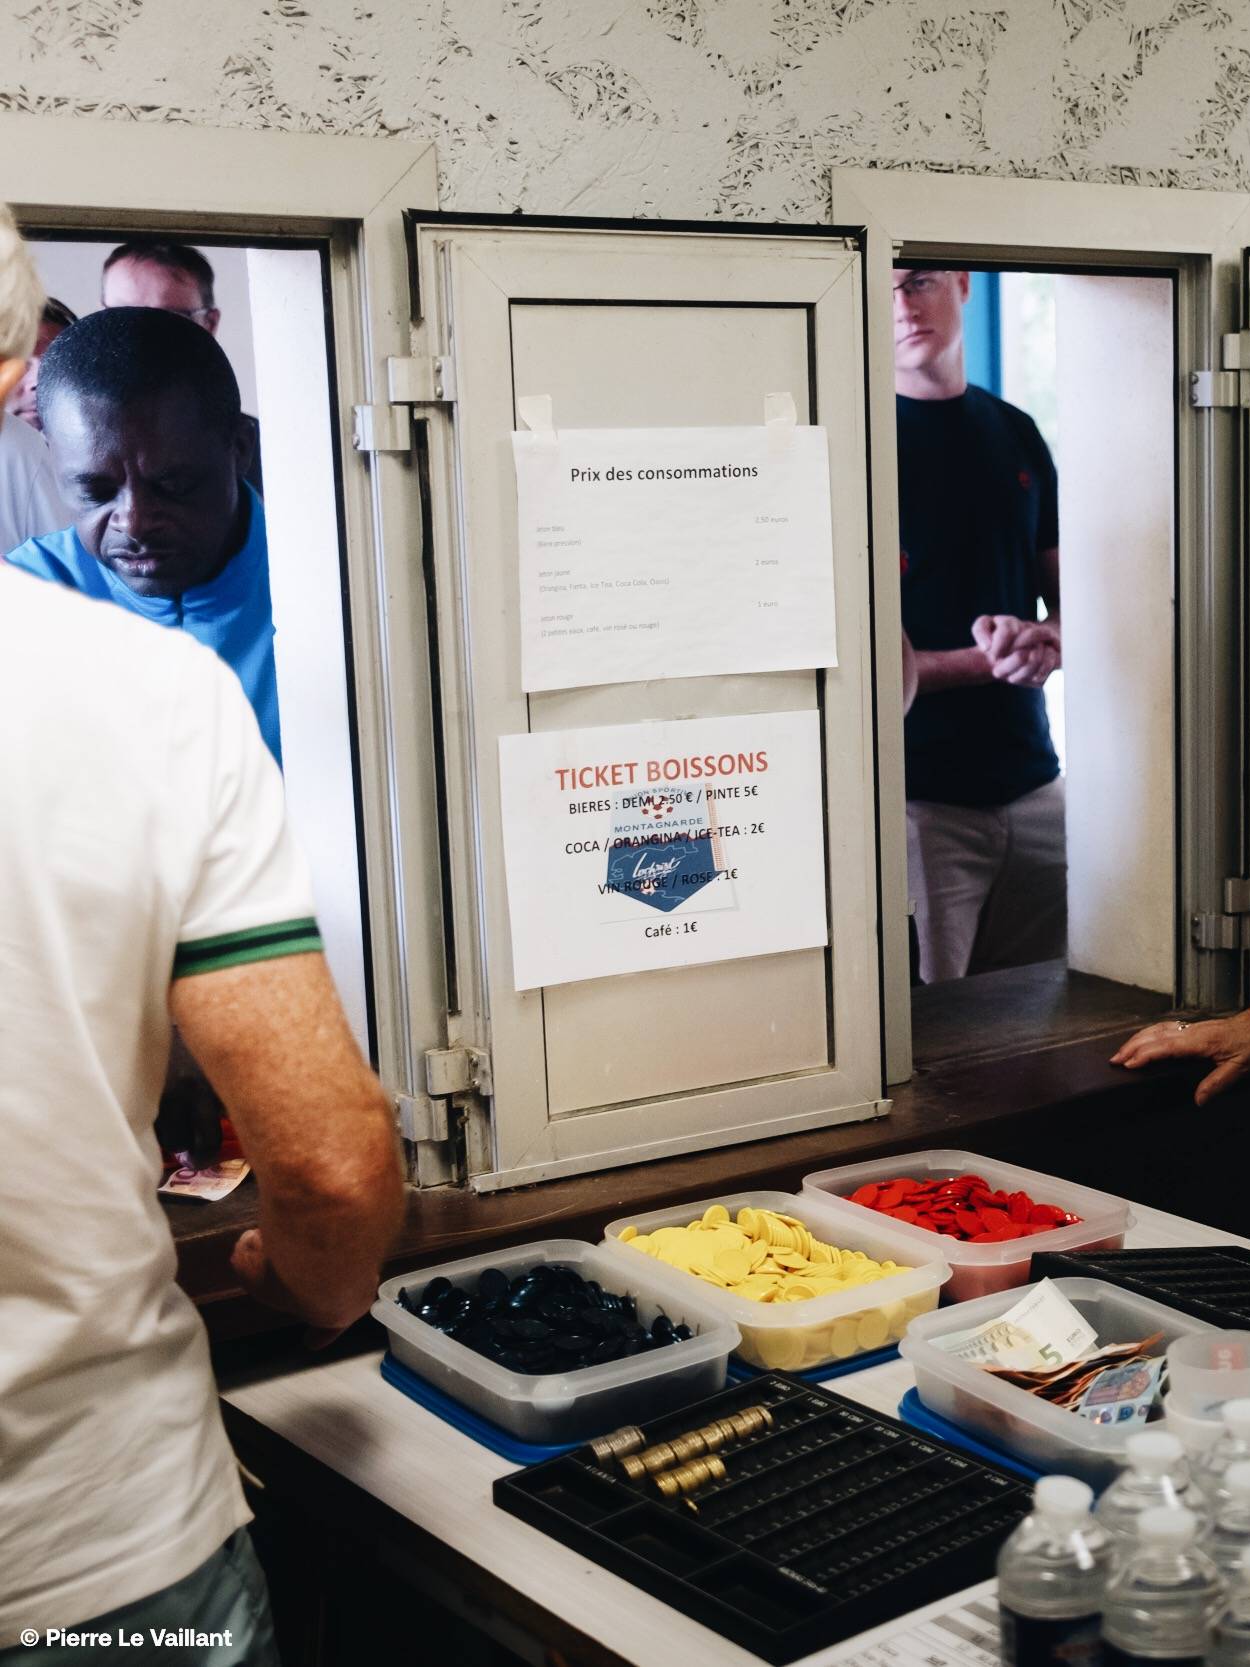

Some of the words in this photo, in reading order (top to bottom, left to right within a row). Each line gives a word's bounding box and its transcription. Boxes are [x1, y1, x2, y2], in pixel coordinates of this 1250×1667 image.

[571, 468, 600, 482] Prix
[606, 466, 632, 481] des
[638, 464, 758, 480] consommations
[555, 763, 638, 791] TICKET
[647, 751, 769, 782] BOISSONS
[569, 800, 611, 814] BIERES
[622, 794, 655, 810] DEMI
[686, 791, 695, 803] €
[697, 789, 702, 804] /
[706, 787, 740, 800] PINTE
[744, 786, 758, 798] 5€
[614, 817, 704, 833] MONTAGNARDE
[565, 840, 600, 854] COCA
[604, 838, 609, 852] /
[613, 831, 682, 849] ORANGINA
[695, 825, 740, 839] ICE-TEA
[751, 823, 765, 835] 2€
[598, 880, 620, 895] VIN
[624, 876, 668, 892] ROUGE
[724, 868, 738, 880] 1€
[645, 923, 672, 939] Café
[683, 921, 698, 934] 1€
[1039, 1343, 1063, 1365] 5
